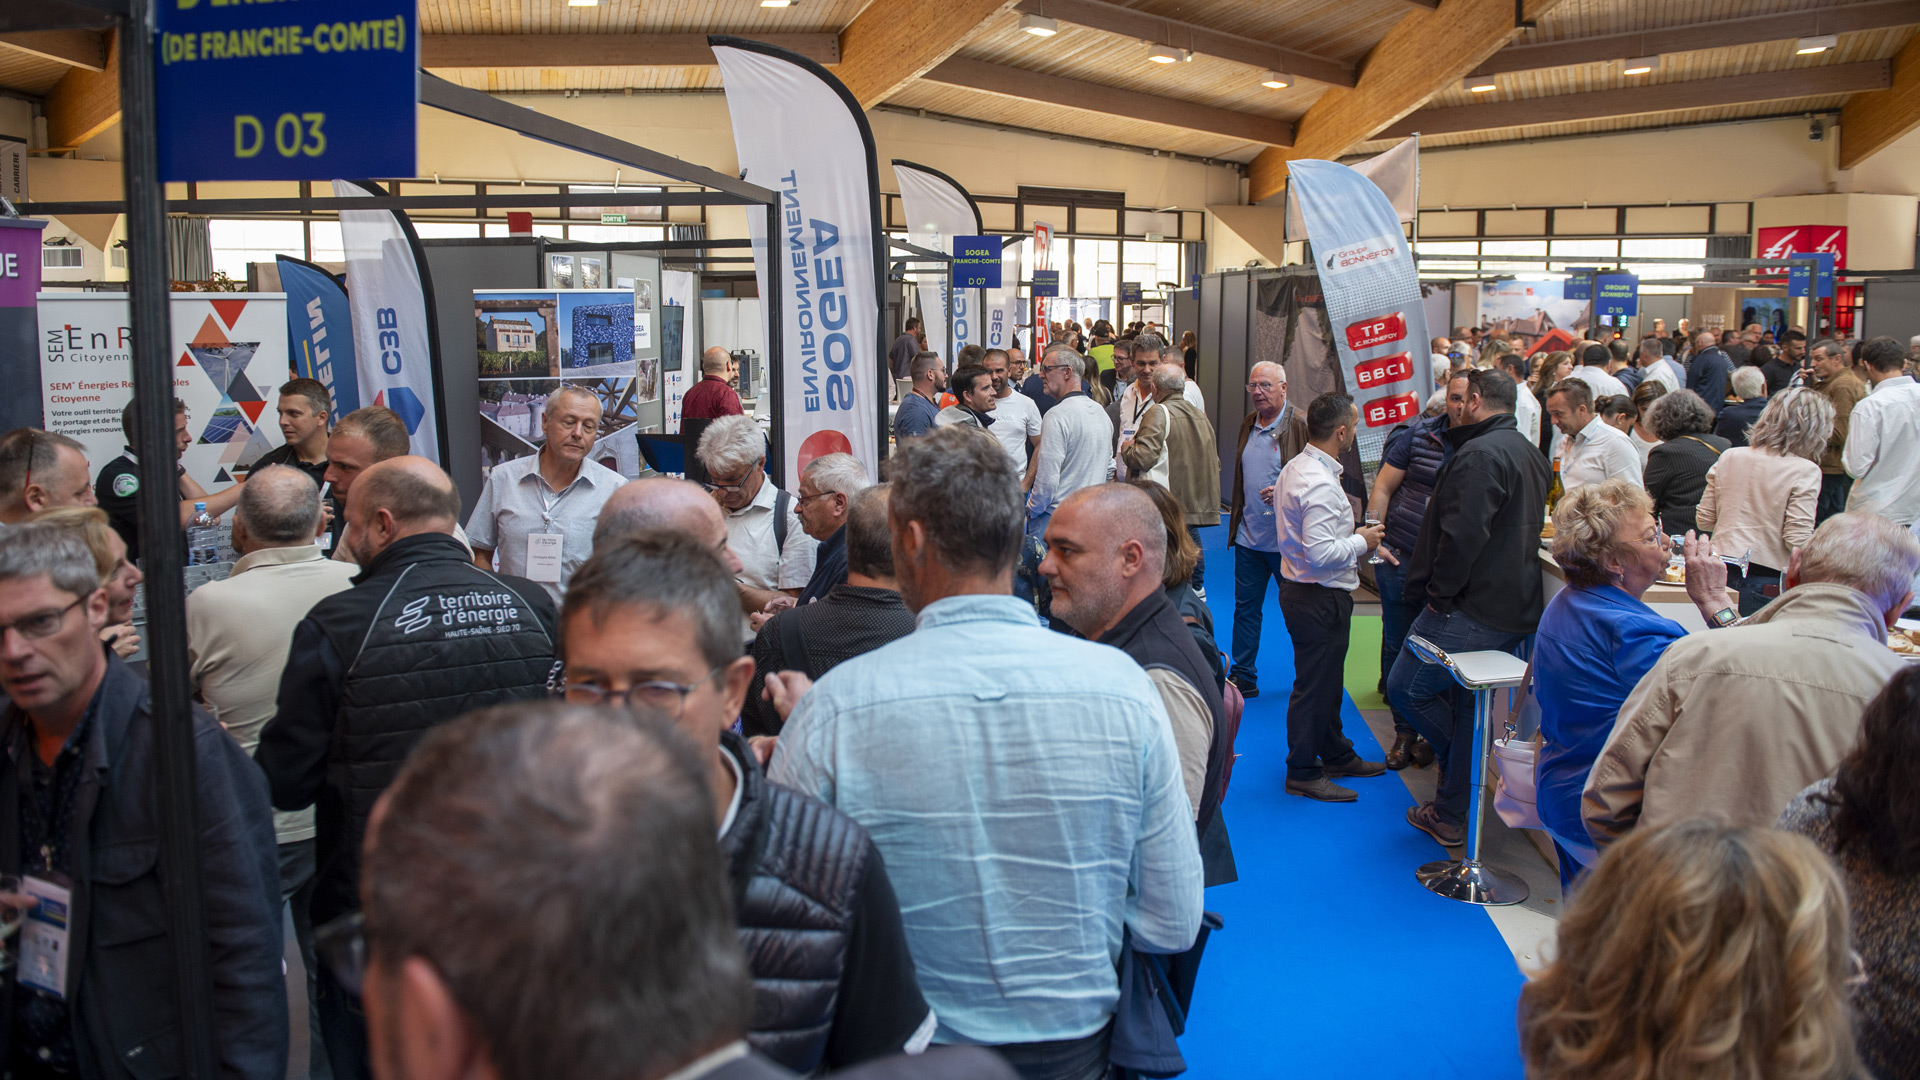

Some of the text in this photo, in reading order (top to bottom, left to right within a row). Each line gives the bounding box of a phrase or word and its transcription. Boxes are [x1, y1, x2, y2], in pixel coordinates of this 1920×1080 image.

[162, 15, 406, 65] (DE FRANCHE-COMTE)
[234, 112, 327, 158] D 03
[1338, 246, 1367, 259] Groupe
[1340, 247, 1395, 267] BONNEFOY
[1702, 314, 1725, 323] VOUS
[990, 309, 1003, 346] C3B
[1361, 322, 1385, 337] TP
[47, 330, 64, 363] SEM
[376, 307, 402, 375] C3B
[70, 353, 132, 364] Citoyenn
[1358, 363, 1405, 383] BBCI
[78, 380, 119, 391] Énergies
[51, 395, 100, 404] Citoyenne
[51, 409, 72, 417] Votre
[74, 408, 91, 416] outil
[63, 419, 91, 427] portage
[438, 591, 512, 610] territoire
[441, 605, 518, 626] d'énergie
[445, 623, 520, 638] HAUTE-SAÔNE SIED 70
